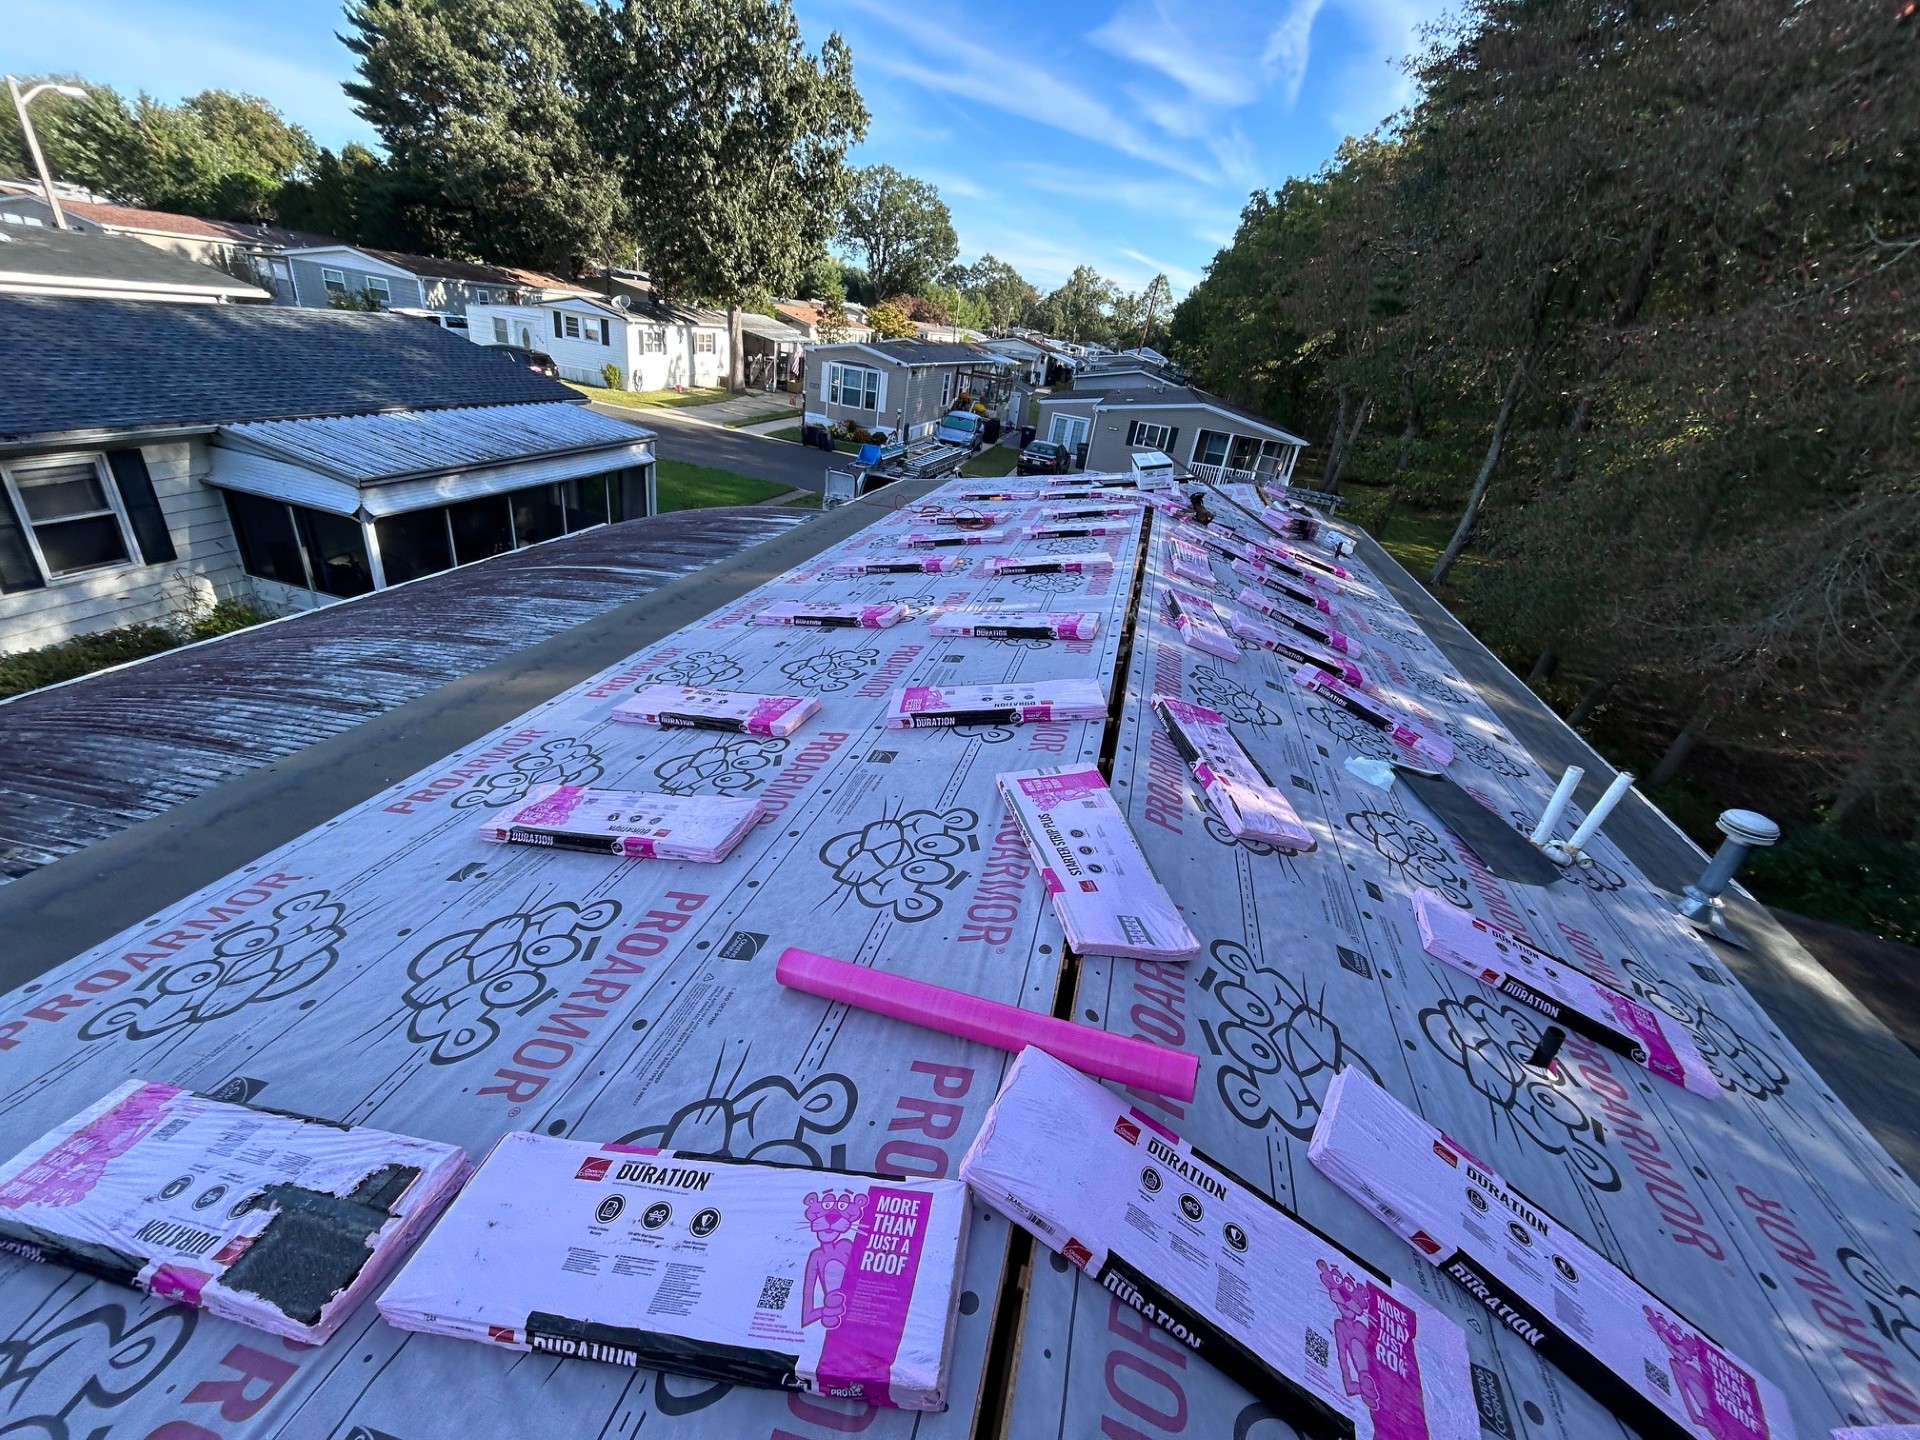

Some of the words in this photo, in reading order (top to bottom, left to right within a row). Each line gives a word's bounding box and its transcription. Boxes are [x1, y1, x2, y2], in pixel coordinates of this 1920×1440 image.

[583, 647, 685, 699] PROARMOR
[853, 644, 925, 699] PROARMOR
[916, 717, 956, 728] DURATION
[382, 727, 548, 815] PROARMOR
[511, 831, 555, 847] DURATION
[1039, 813, 1056, 828] PLUS
[1046, 829, 1066, 846] STRIP
[1056, 846, 1082, 876] STARTER
[0, 872, 304, 1051] PROARMOR
[1491, 930, 1540, 961] DURATION
[475, 890, 711, 1104] PROARMOR
[1503, 982, 1560, 1019] DURATION
[615, 1163, 712, 1191] DURATION
[1147, 1139, 1228, 1202] DURATION
[876, 1195, 921, 1217] MORE
[1466, 1165, 1550, 1237] DURATION
[133, 1218, 222, 1255] DURATION
[873, 1213, 917, 1237] THAN
[866, 1234, 899, 1252] JUST
[900, 1240, 910, 1254] A
[860, 1251, 908, 1276] ROOF
[1103, 1271, 1204, 1349] DURATION
[1376, 1295, 1409, 1328] MORE
[1449, 1262, 1547, 1347] DURATION
[1378, 1330, 1405, 1356] JUST
[1706, 1349, 1749, 1387] MORE
[1711, 1364, 1753, 1407] THAN
[1474, 1366, 1495, 1418] OWENS
[1484, 1370, 1509, 1434] CORNING
